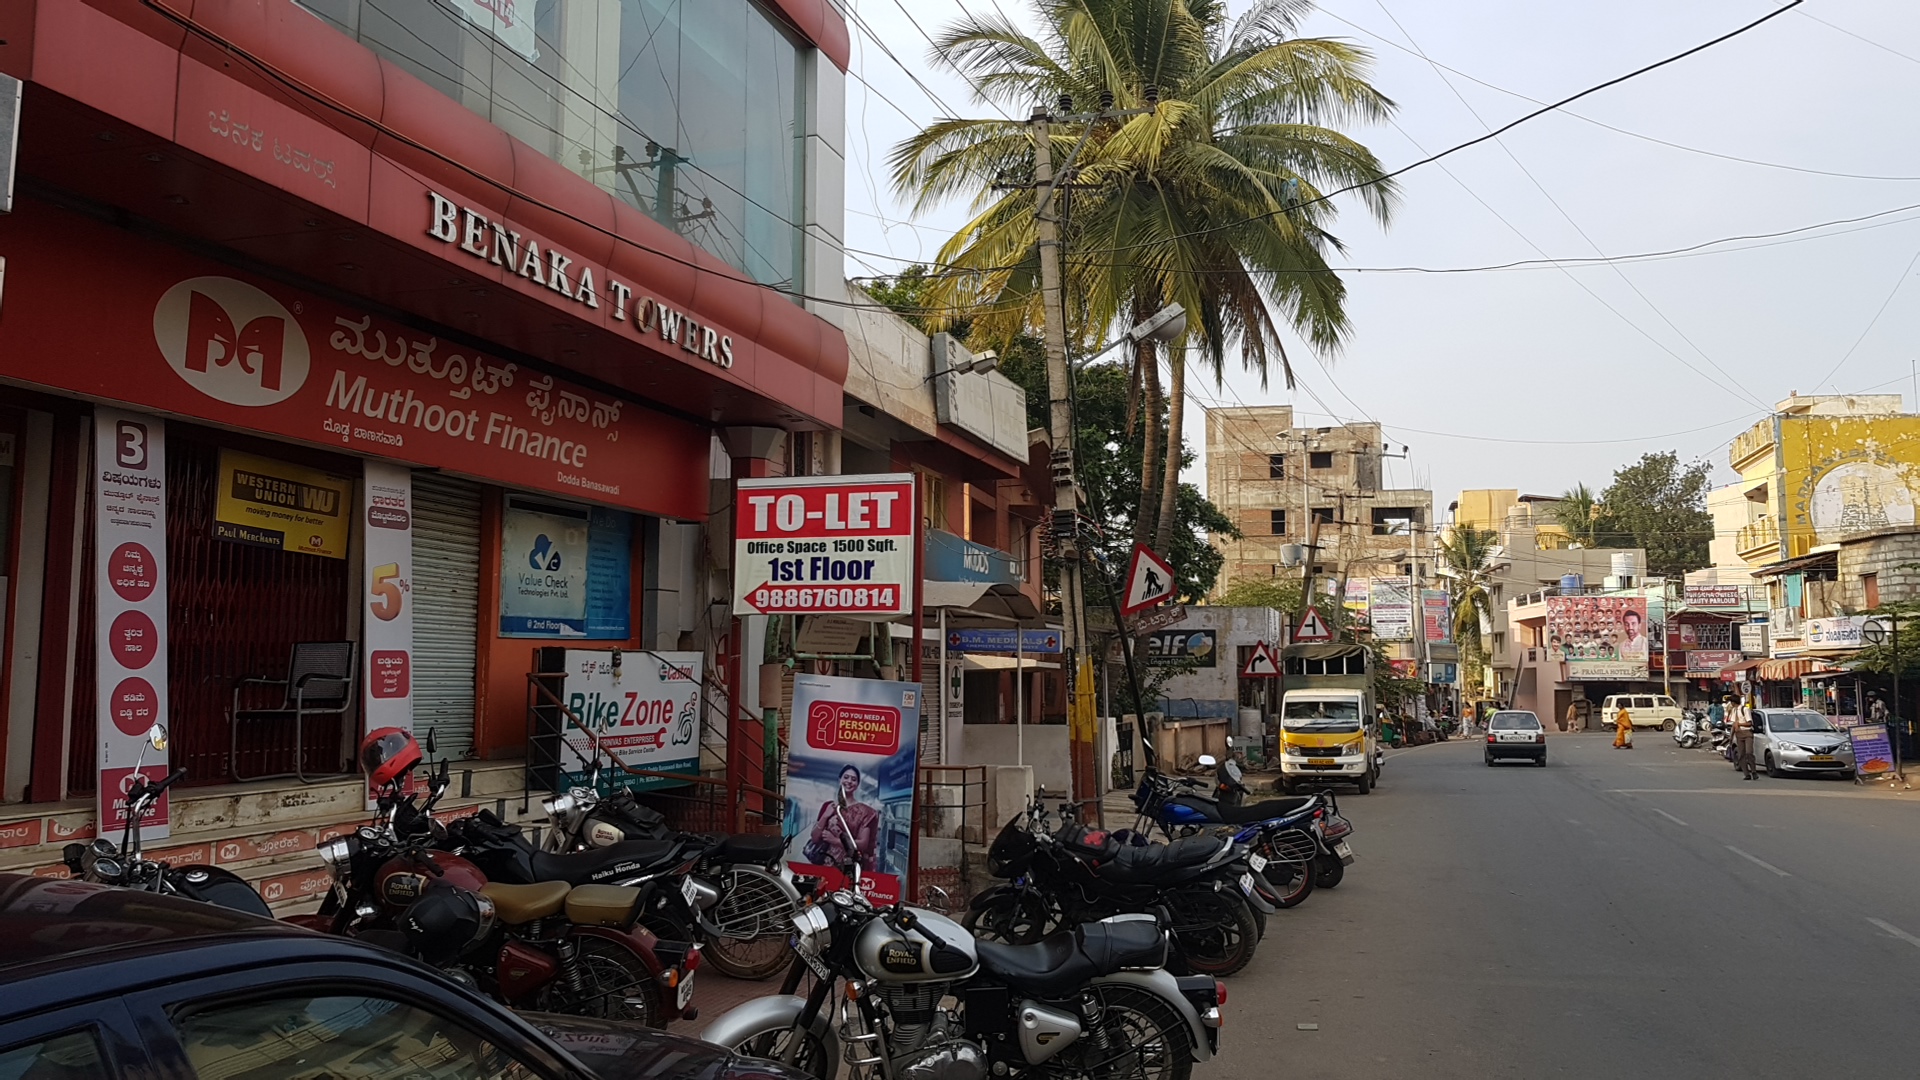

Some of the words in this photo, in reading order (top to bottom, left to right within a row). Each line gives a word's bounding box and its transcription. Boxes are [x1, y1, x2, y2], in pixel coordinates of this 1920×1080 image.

[427, 191, 600, 310] BENAKA
[608, 279, 735, 370] TOWERS
[325, 369, 481, 442] Muthoot
[484, 411, 588, 468] Finance
[120, 425, 146, 465] 3
[236, 473, 298, 498] WESTERN
[557, 470, 580, 487] Dodda
[581, 475, 621, 496] Banasawadi
[254, 488, 296, 507] UNION
[302, 486, 336, 514] WU
[245, 506, 271, 518] moving
[271, 513, 295, 524] money
[295, 515, 305, 524] for
[305, 517, 325, 527] better
[748, 491, 899, 533] TO-LET
[747, 541, 784, 555] Office
[786, 540, 827, 555] Space
[832, 539, 865, 553] 1500
[867, 538, 898, 554] Sqft.
[768, 557, 804, 582] 1st
[809, 556, 875, 582] Floor
[518, 572, 543, 586] Value
[544, 574, 568, 589] Check
[518, 586, 550, 598] Technologies
[755, 588, 894, 608] 9886760814
[533, 620, 545, 630] 2nd
[667, 669, 693, 686] Castrol
[1581, 668, 1610, 679] PRAMILA
[1609, 668, 1632, 679] HOTEL
[840, 711, 849, 719] DO
[850, 713, 864, 721] YOU
[864, 714, 881, 723] NEED
[839, 719, 893, 733] PERSONAL
[591, 868, 616, 881] Haiku
[614, 861, 642, 875] Honda
[388, 888, 415, 898] ENFIELD
[390, 882, 413, 891] ROYAL
[867, 890, 895, 901] Finance
[886, 955, 917, 966] ENFIELD
[888, 948, 914, 958] ROYAL
